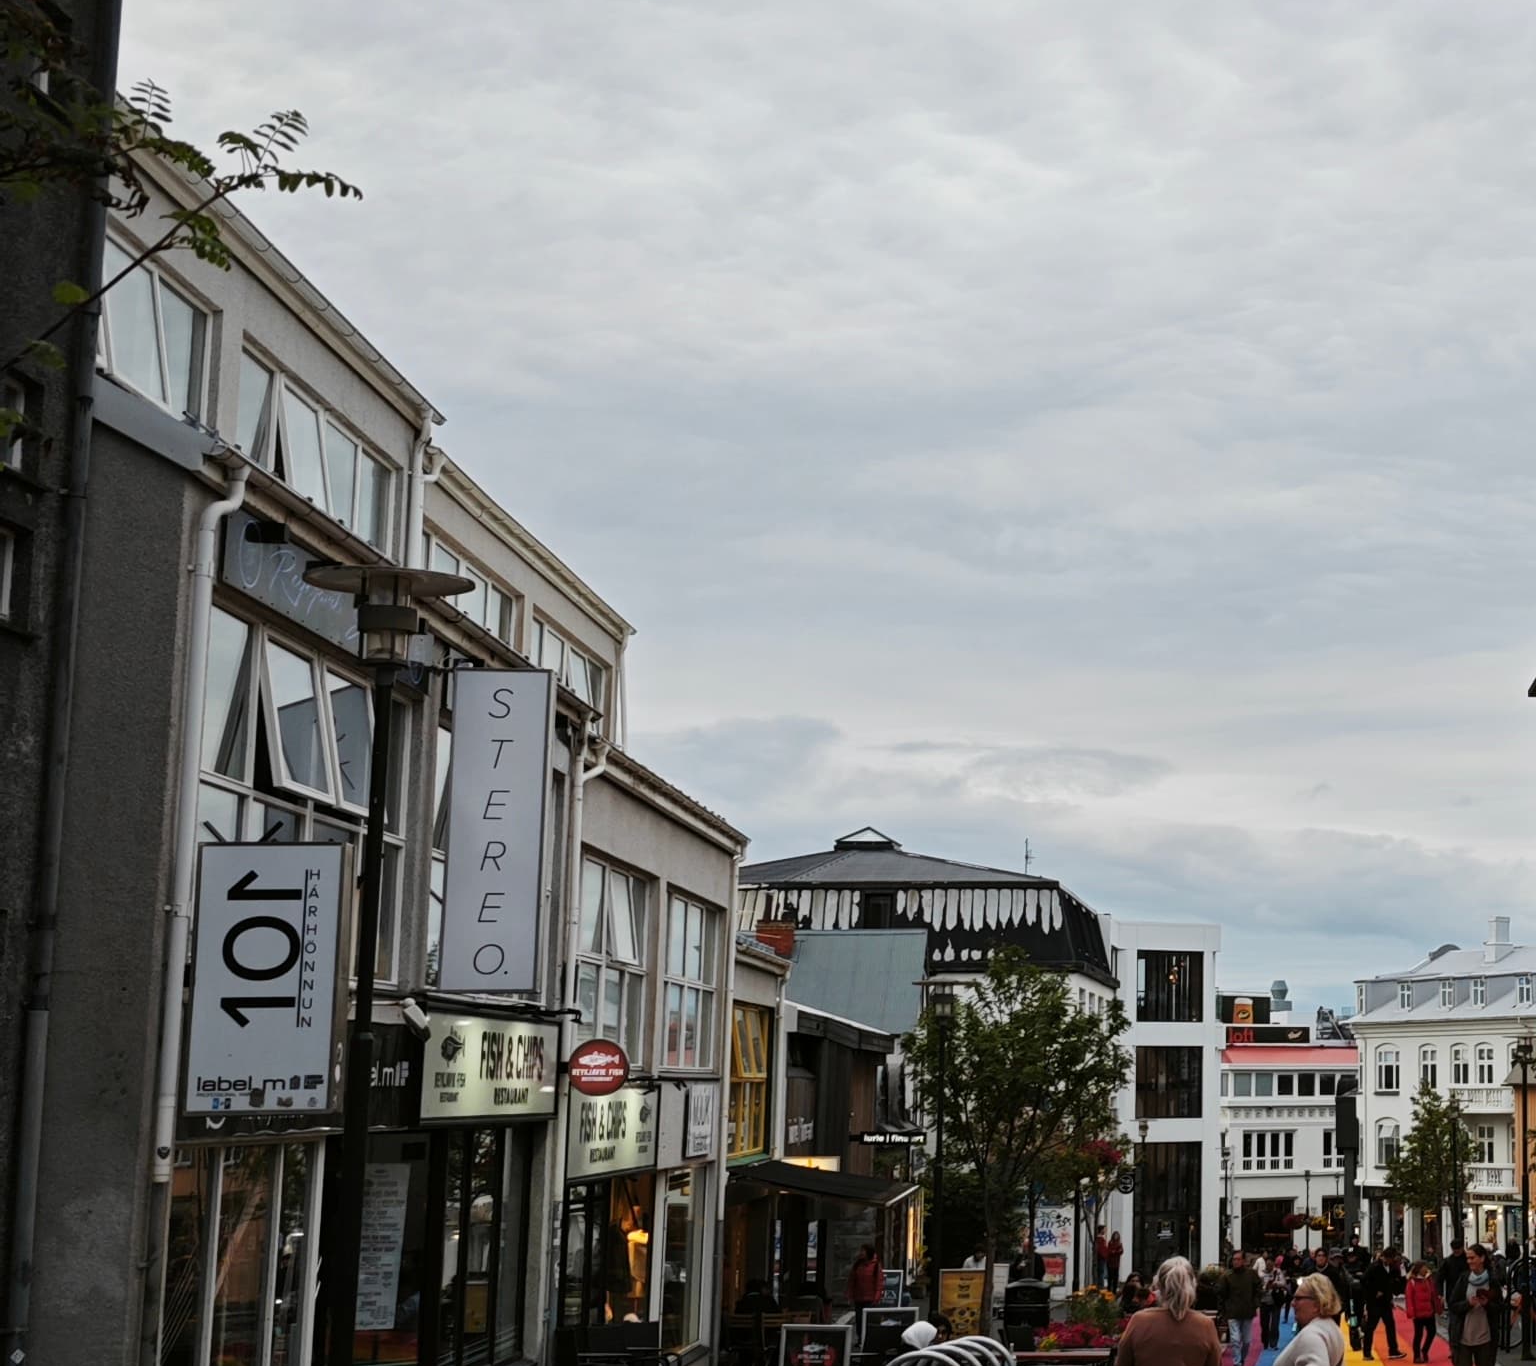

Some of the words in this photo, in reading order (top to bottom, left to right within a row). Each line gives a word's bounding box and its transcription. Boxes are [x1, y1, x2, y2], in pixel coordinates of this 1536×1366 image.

[473, 688, 515, 975] STEREO.
[222, 870, 303, 1028] 101
[479, 1031, 505, 1081] FISH
[505, 1036, 514, 1081] &
[515, 1035, 545, 1082] CHIPS
[493, 1088, 529, 1105] RESTAURANT
[580, 1101, 597, 1144] FISH
[599, 1103, 604, 1141] &
[607, 1100, 627, 1140] CHIPS
